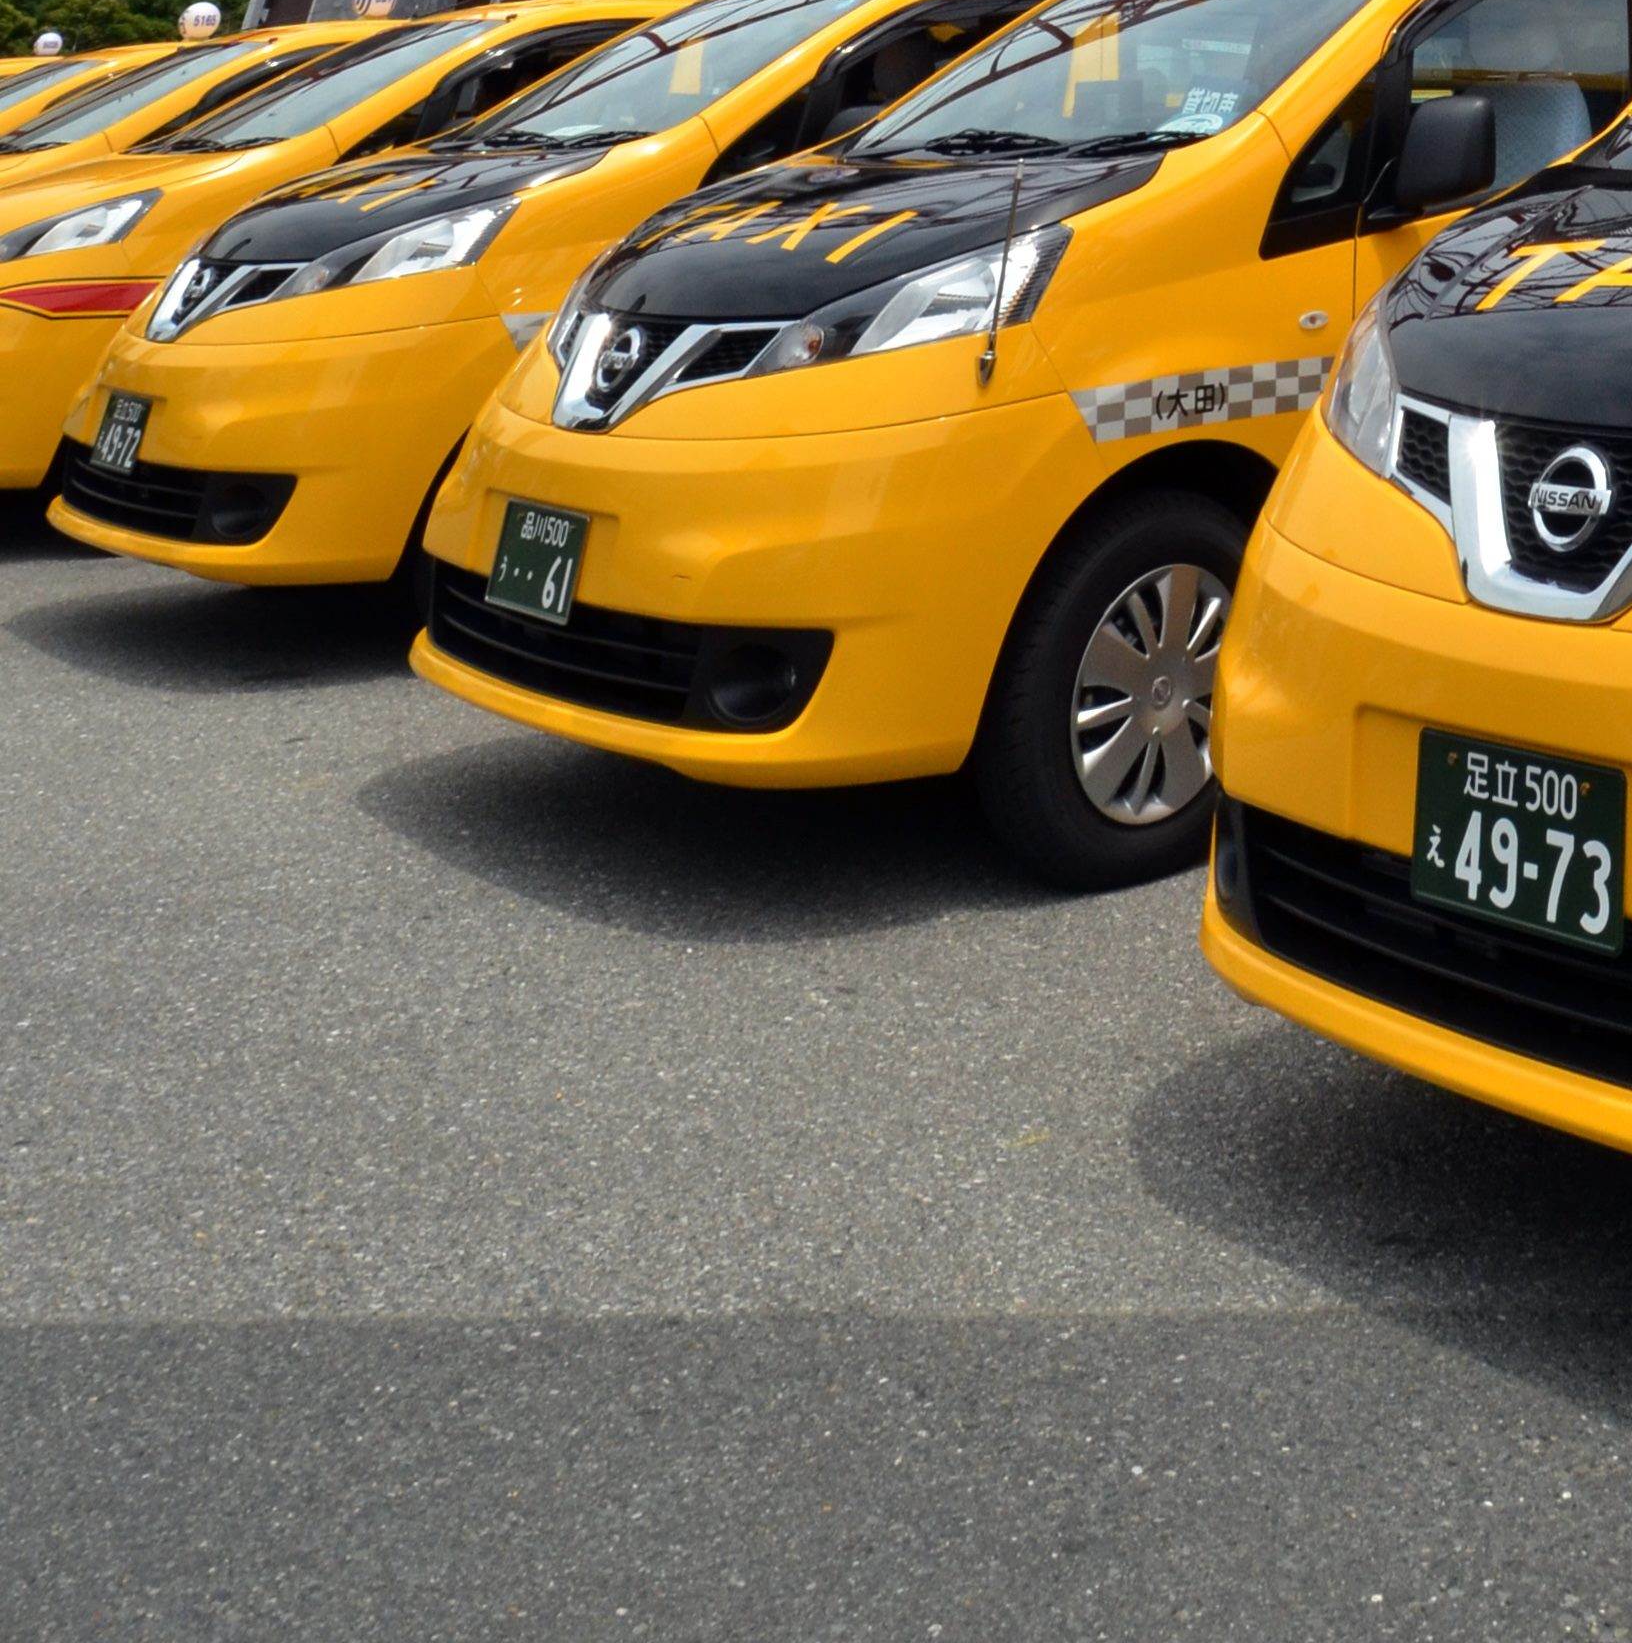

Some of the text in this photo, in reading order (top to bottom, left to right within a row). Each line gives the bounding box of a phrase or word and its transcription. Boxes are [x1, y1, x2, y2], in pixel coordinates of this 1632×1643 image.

[636, 199, 919, 264] TAXI
[1155, 382, 1226, 421] (大田)
[101, 422, 142, 468] 49-72
[1533, 488, 1598, 510] NISSAN
[1426, 810, 1612, 935] え 49-73
